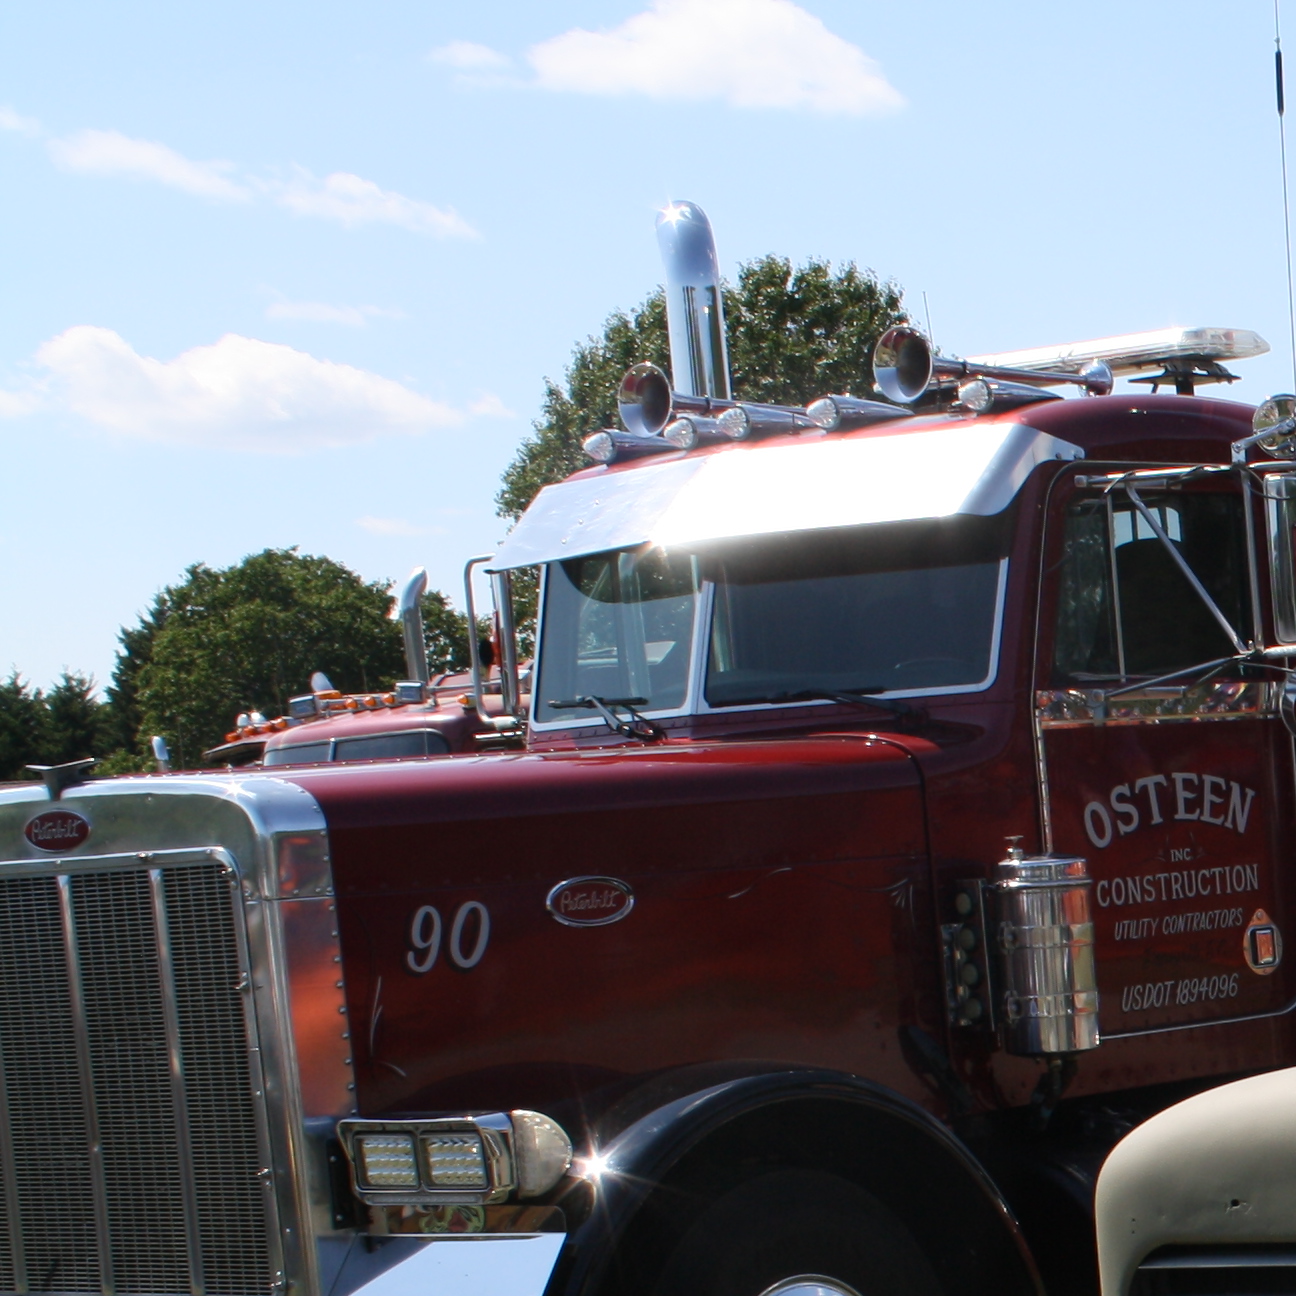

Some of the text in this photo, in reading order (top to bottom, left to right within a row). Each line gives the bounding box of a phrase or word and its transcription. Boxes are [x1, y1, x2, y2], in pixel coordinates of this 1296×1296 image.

[1083, 772, 1256, 849] OSTEEN
[31, 819, 83, 842] Peterbilt
[1170, 848, 1193, 863] INC
[560, 890, 621, 914] Peterbilt
[1097, 864, 1260, 908] CONSTRUCTION
[406, 900, 491, 973] 90
[1114, 908, 1243, 941] UTILITY CONTRACTORS
[1121, 973, 1239, 1013] USDOT 1894096
